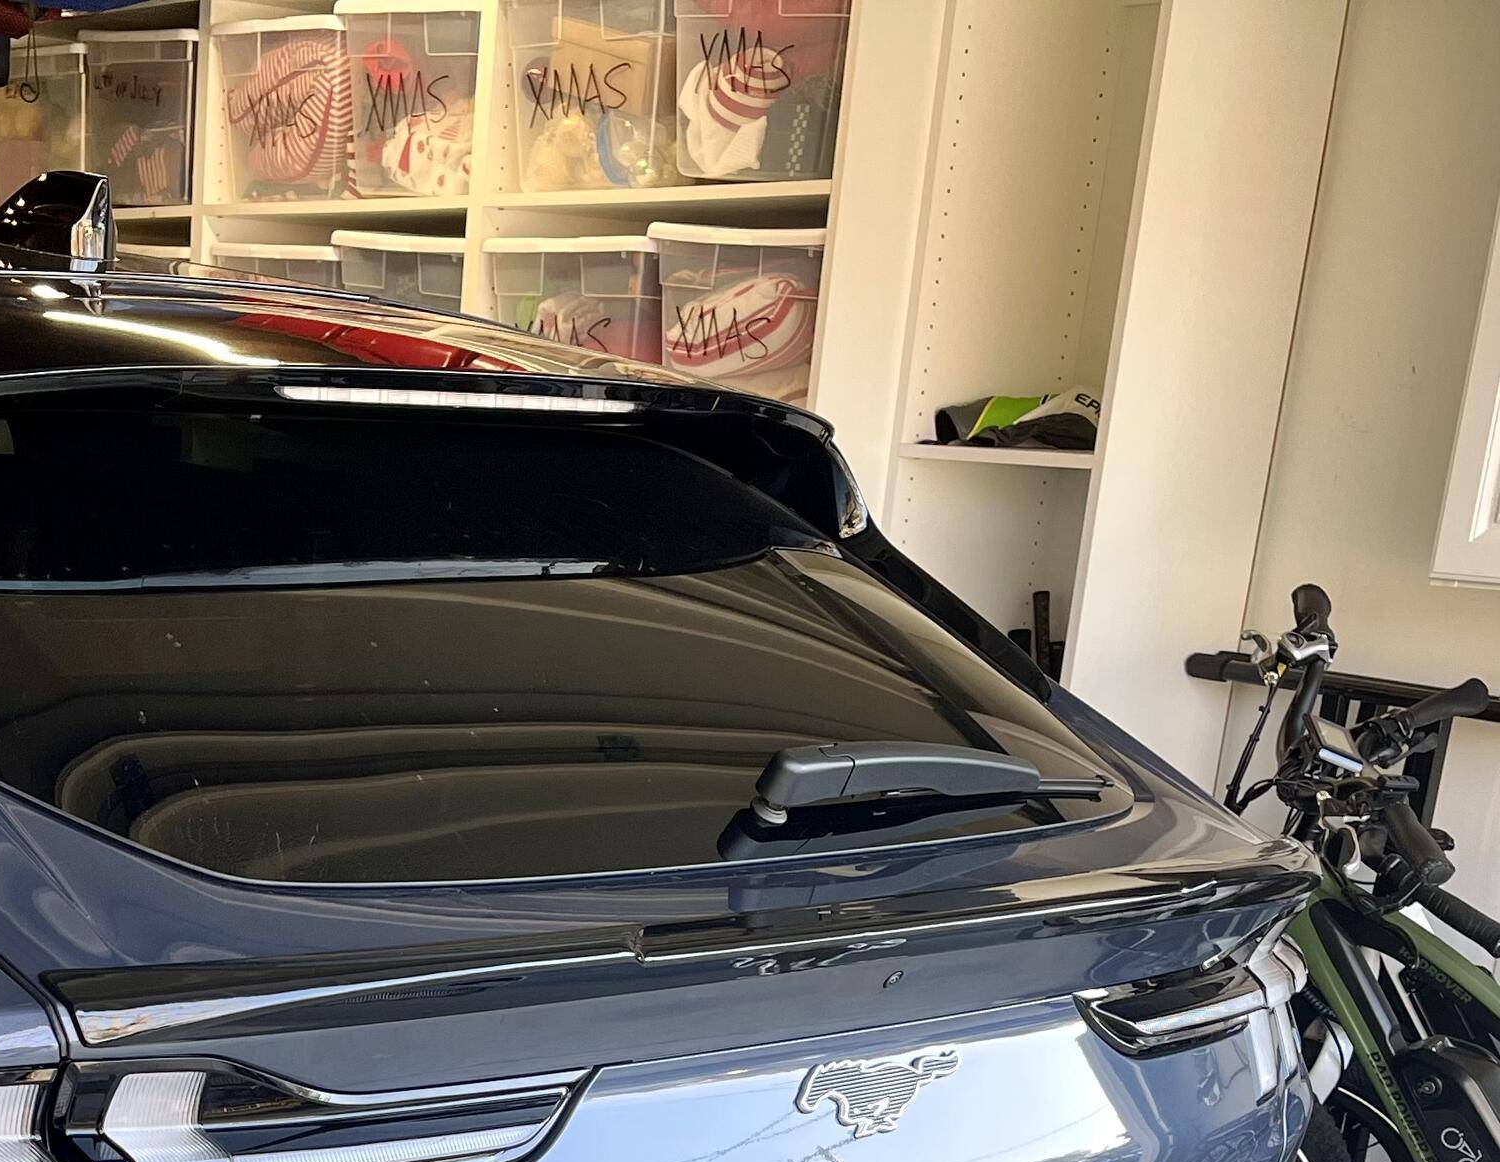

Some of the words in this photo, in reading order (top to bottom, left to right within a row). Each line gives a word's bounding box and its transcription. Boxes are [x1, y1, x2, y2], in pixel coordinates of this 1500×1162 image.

[695, 27, 795, 94] XMAS
[247, 91, 317, 149] XMAS
[365, 70, 450, 136] XMAS
[526, 63, 632, 128] XMAS
[672, 305, 771, 362] XMAS
